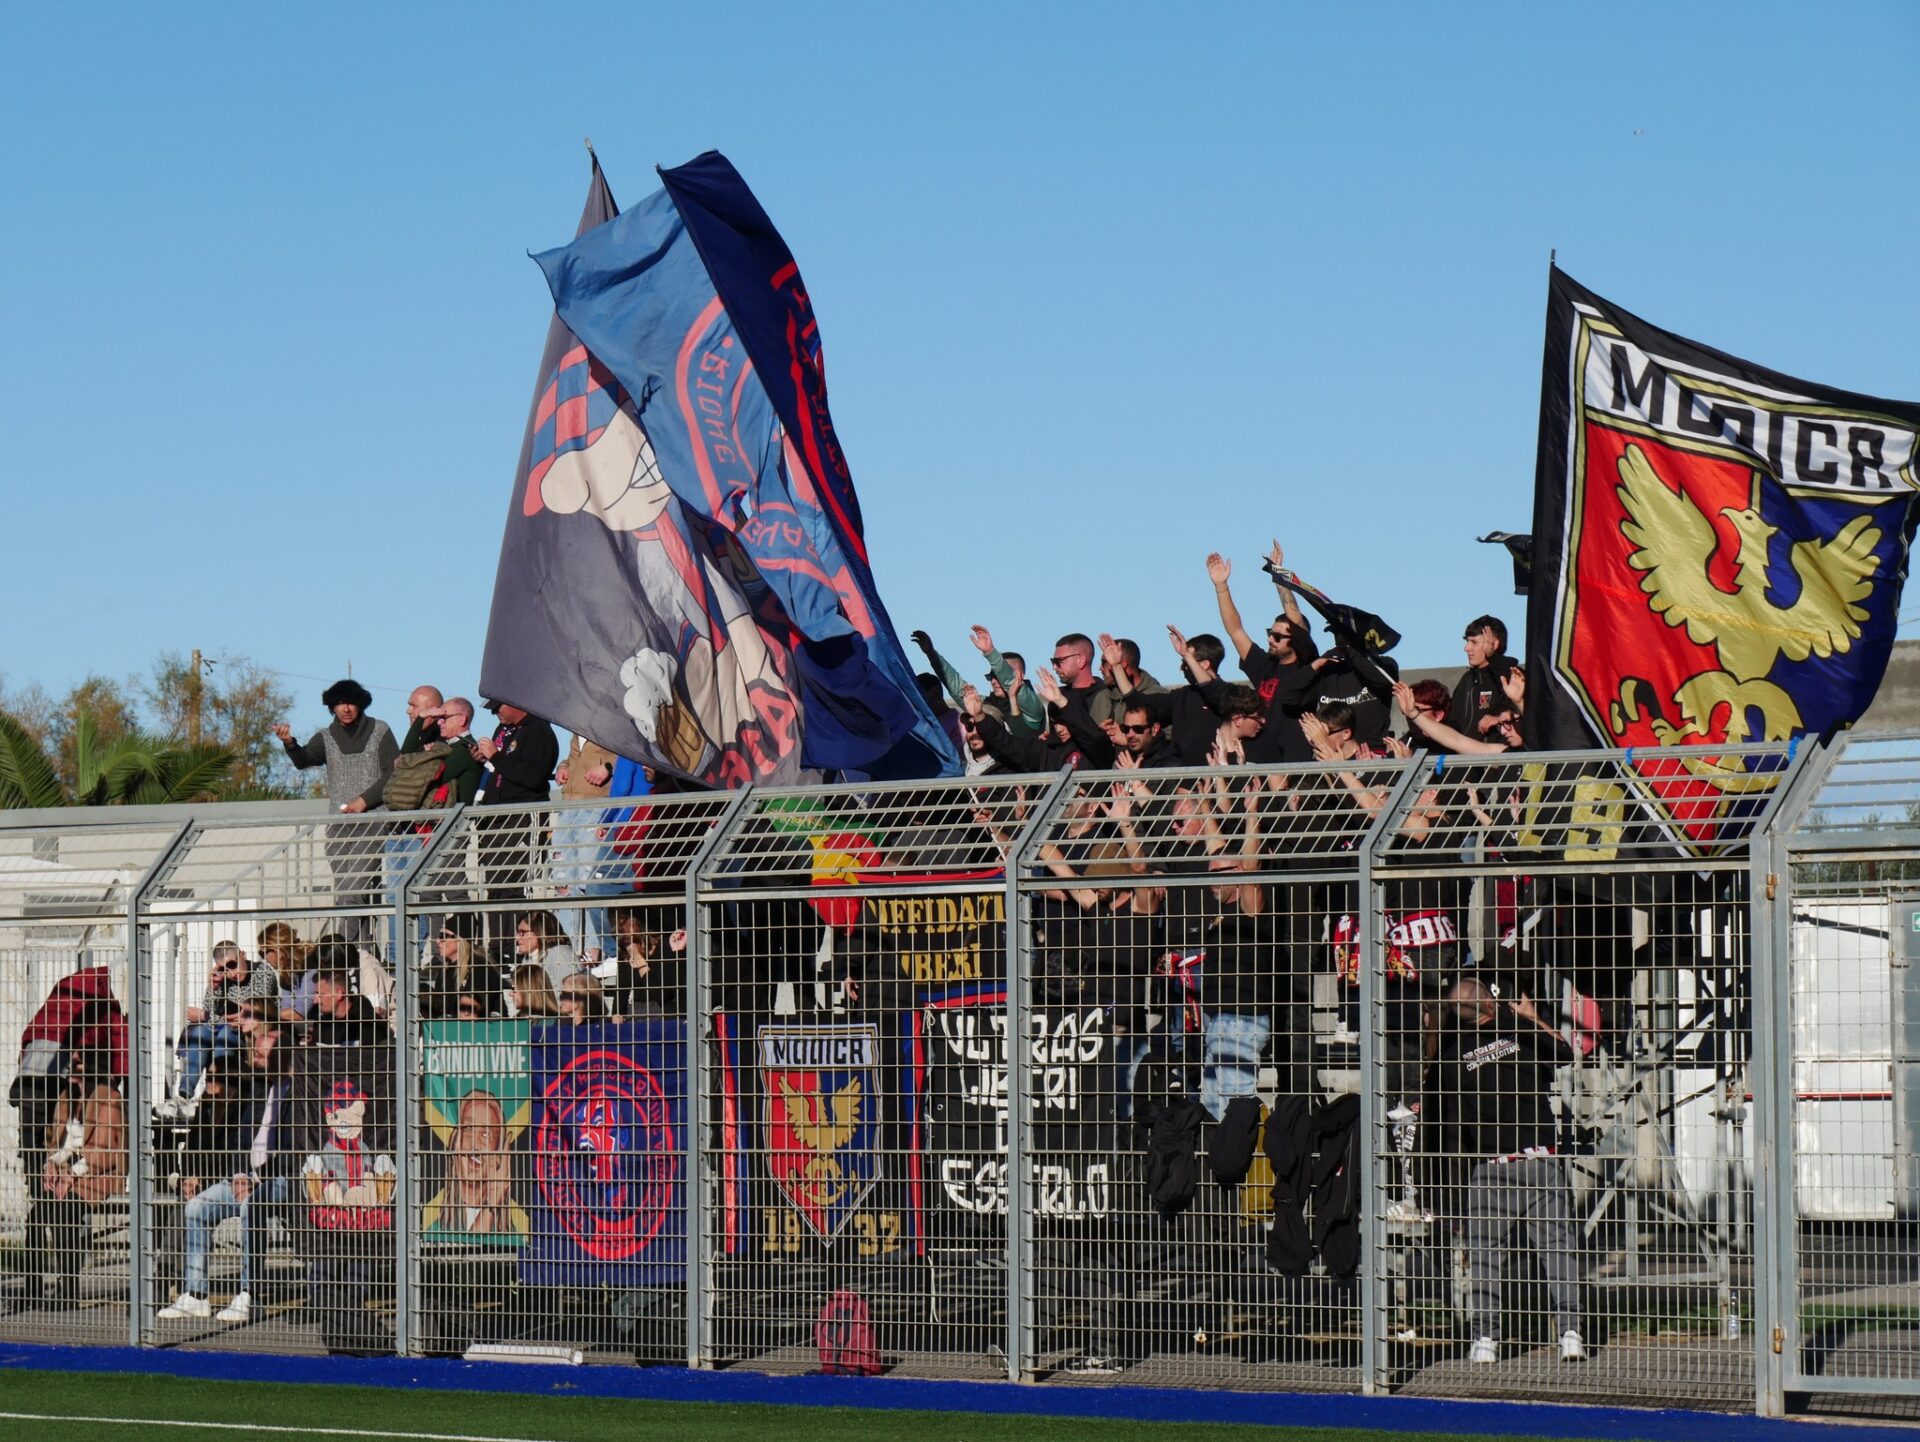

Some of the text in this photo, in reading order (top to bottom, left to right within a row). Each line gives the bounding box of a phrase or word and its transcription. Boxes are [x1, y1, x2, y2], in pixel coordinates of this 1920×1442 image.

[490, 1040, 528, 1079] VIVE
[773, 1036, 864, 1065] MODICA
[762, 1208, 901, 1256] 19 32
